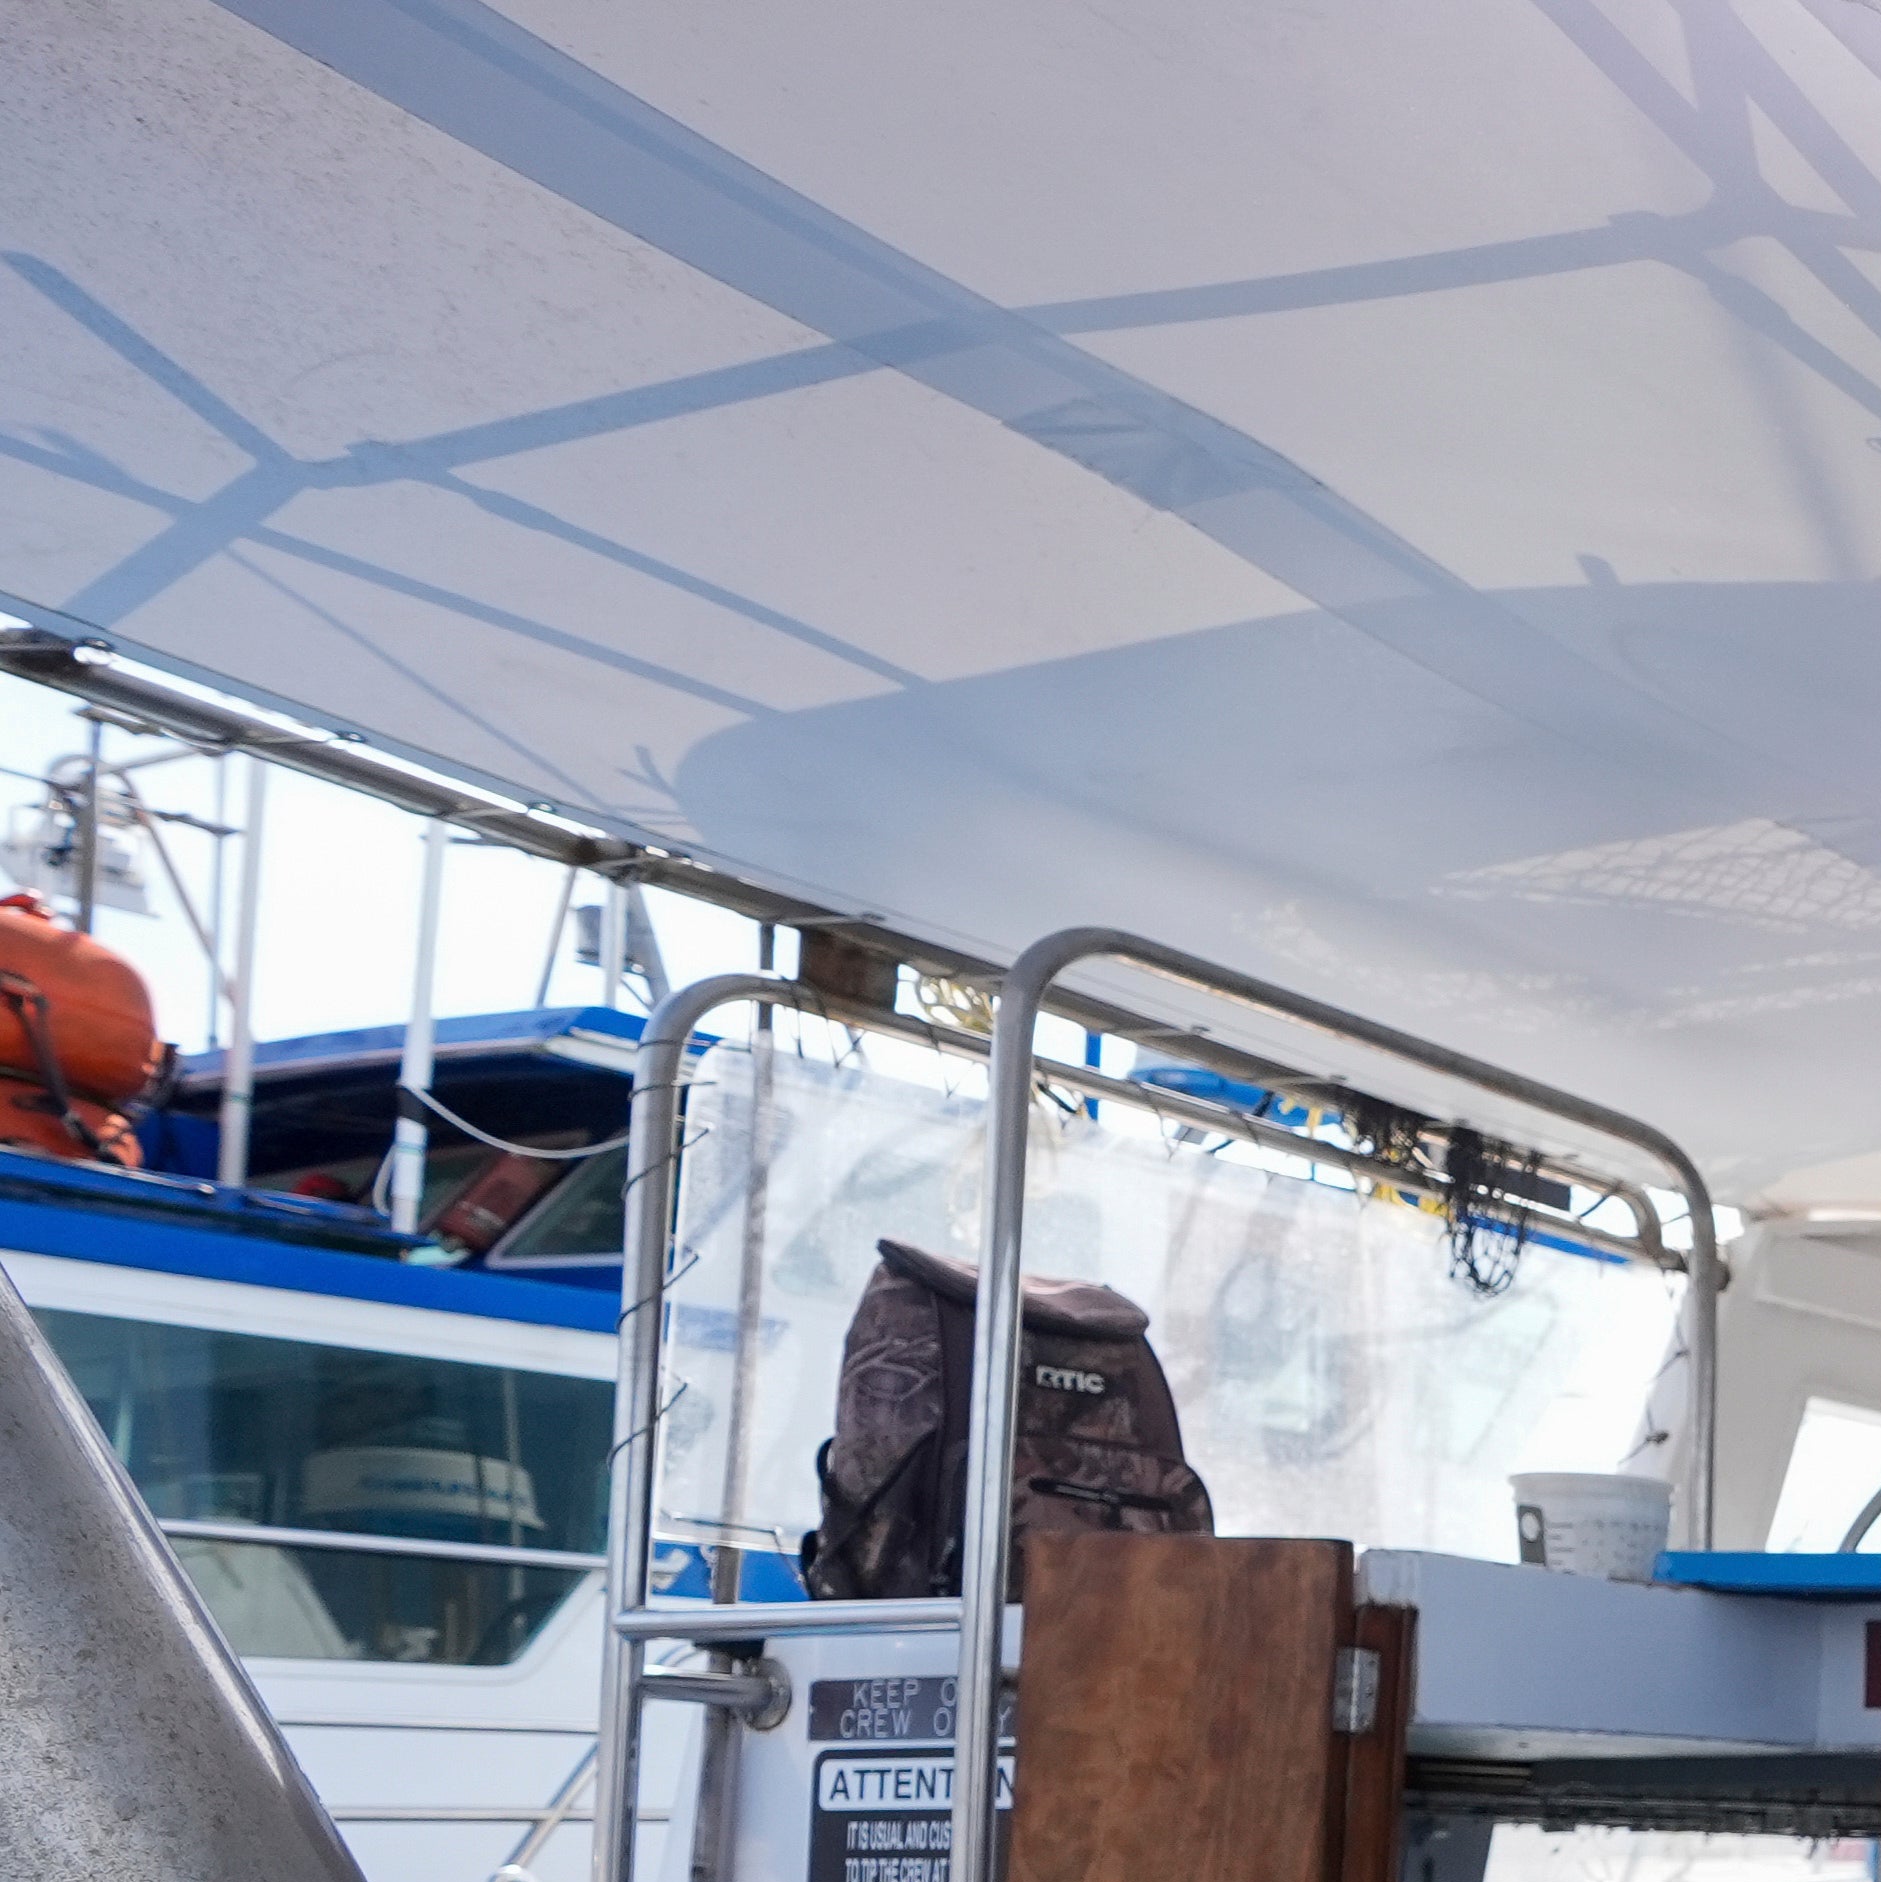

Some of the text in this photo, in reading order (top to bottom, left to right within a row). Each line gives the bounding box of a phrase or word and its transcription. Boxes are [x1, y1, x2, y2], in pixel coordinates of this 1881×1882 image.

[853, 1678, 920, 1709] KEEP
[840, 1706, 1012, 1739] CREW OY
[829, 1767, 1014, 1800] ATTENTN
[858, 1820, 869, 1850] IS
[870, 1820, 904, 1850] USUAL
[905, 1820, 928, 1850] AND
